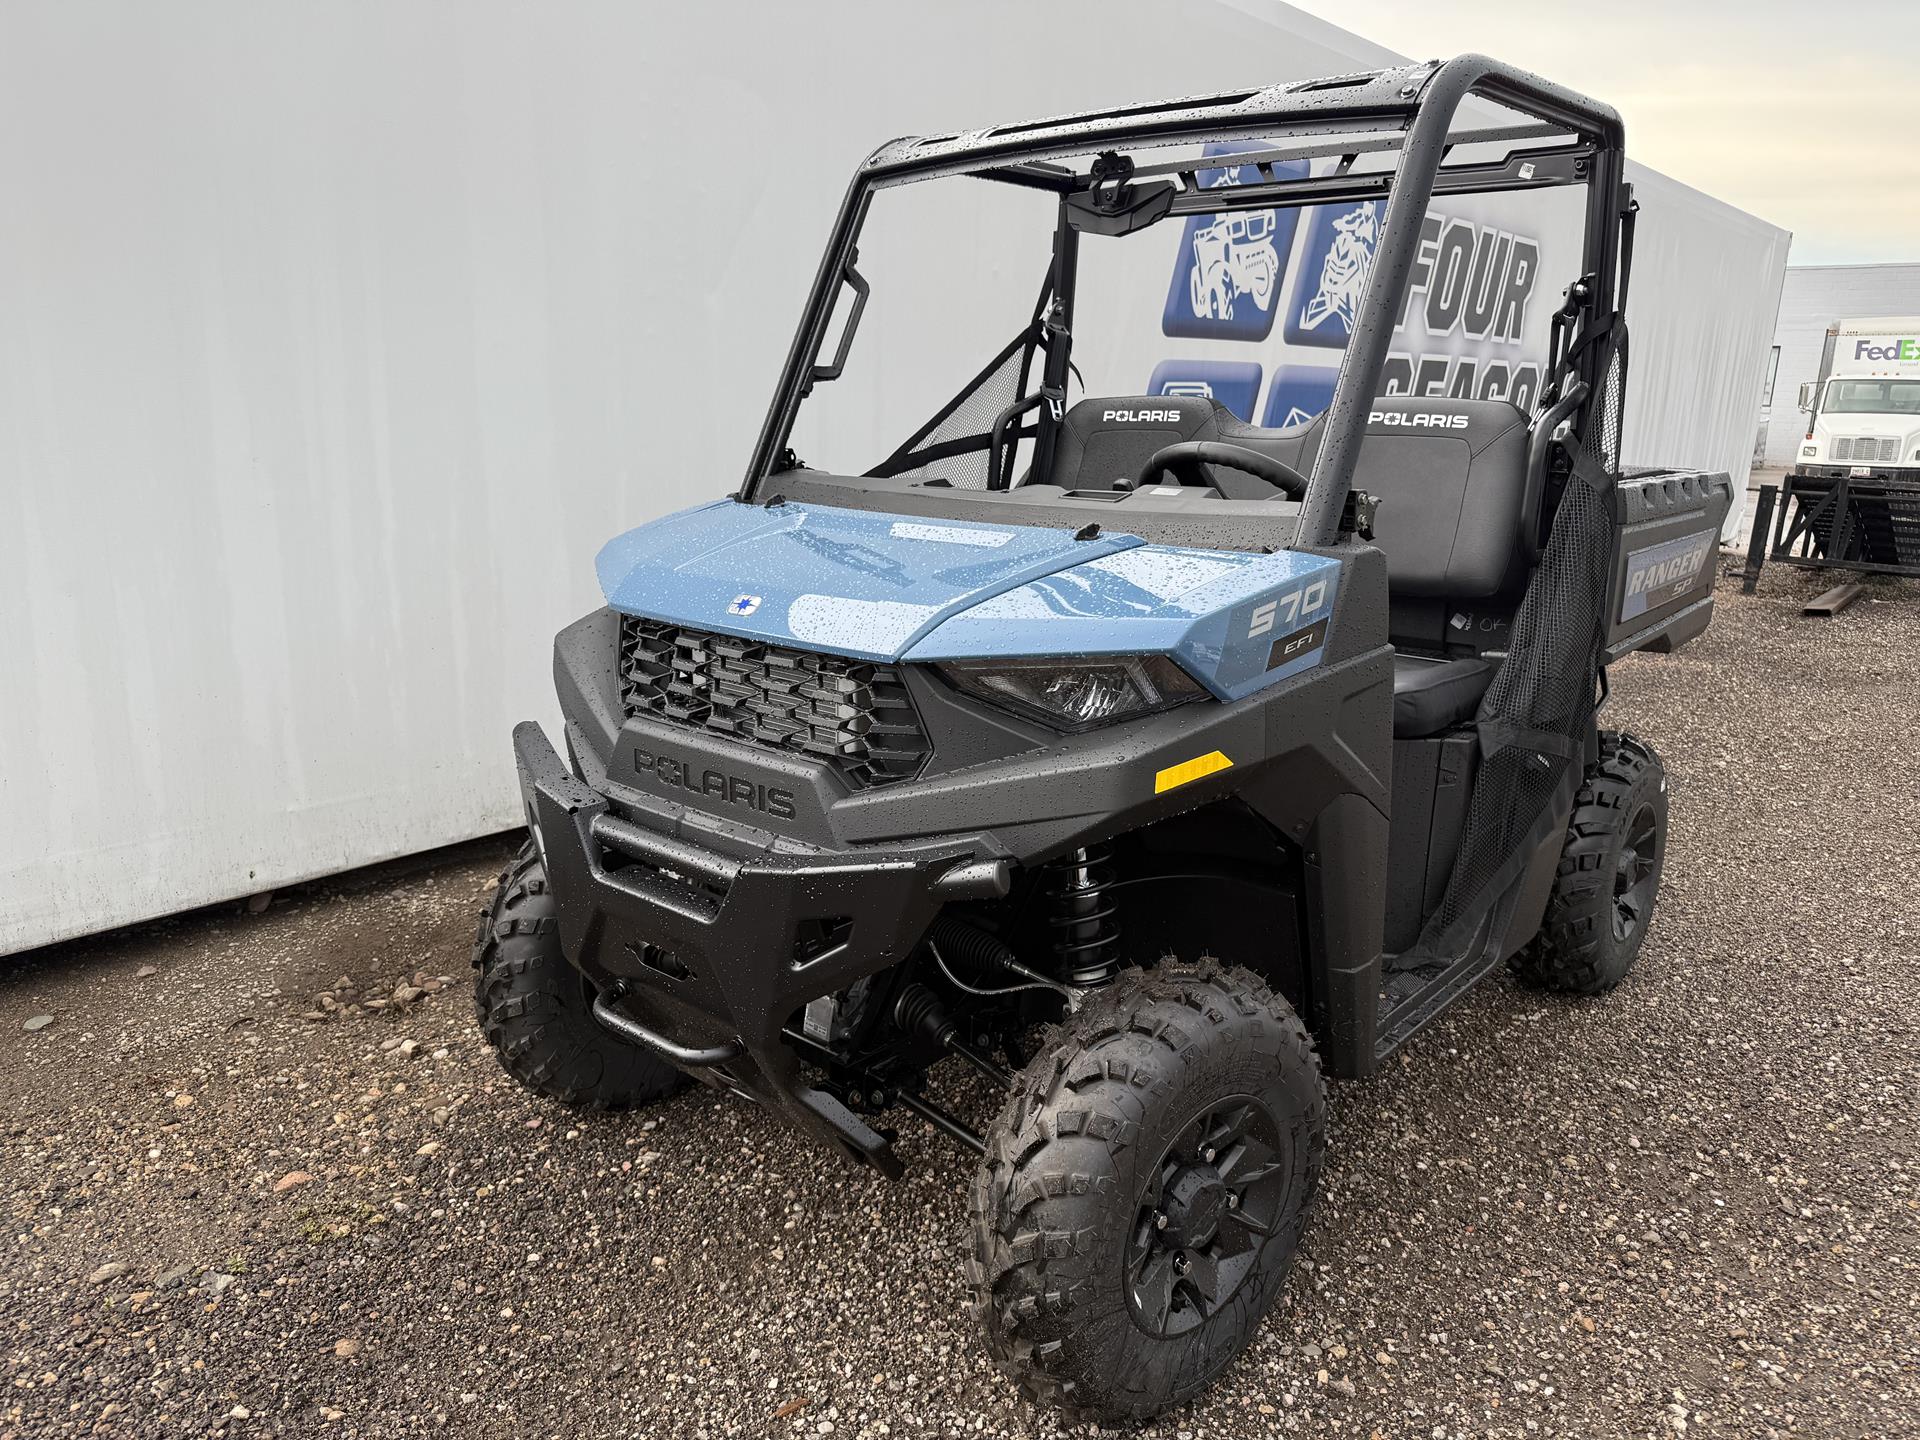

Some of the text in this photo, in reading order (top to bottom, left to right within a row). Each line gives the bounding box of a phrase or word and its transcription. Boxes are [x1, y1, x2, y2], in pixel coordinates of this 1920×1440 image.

[1395, 211, 1540, 344] FOUR
[1102, 410, 1181, 422] POLARIS
[1367, 412, 1469, 428] POLARIS
[1627, 549, 1703, 597] RANGER
[1671, 578, 1693, 596] SP
[1247, 579, 1327, 639] 570
[1283, 633, 1313, 655] EFI
[633, 748, 796, 821] POLARIS
